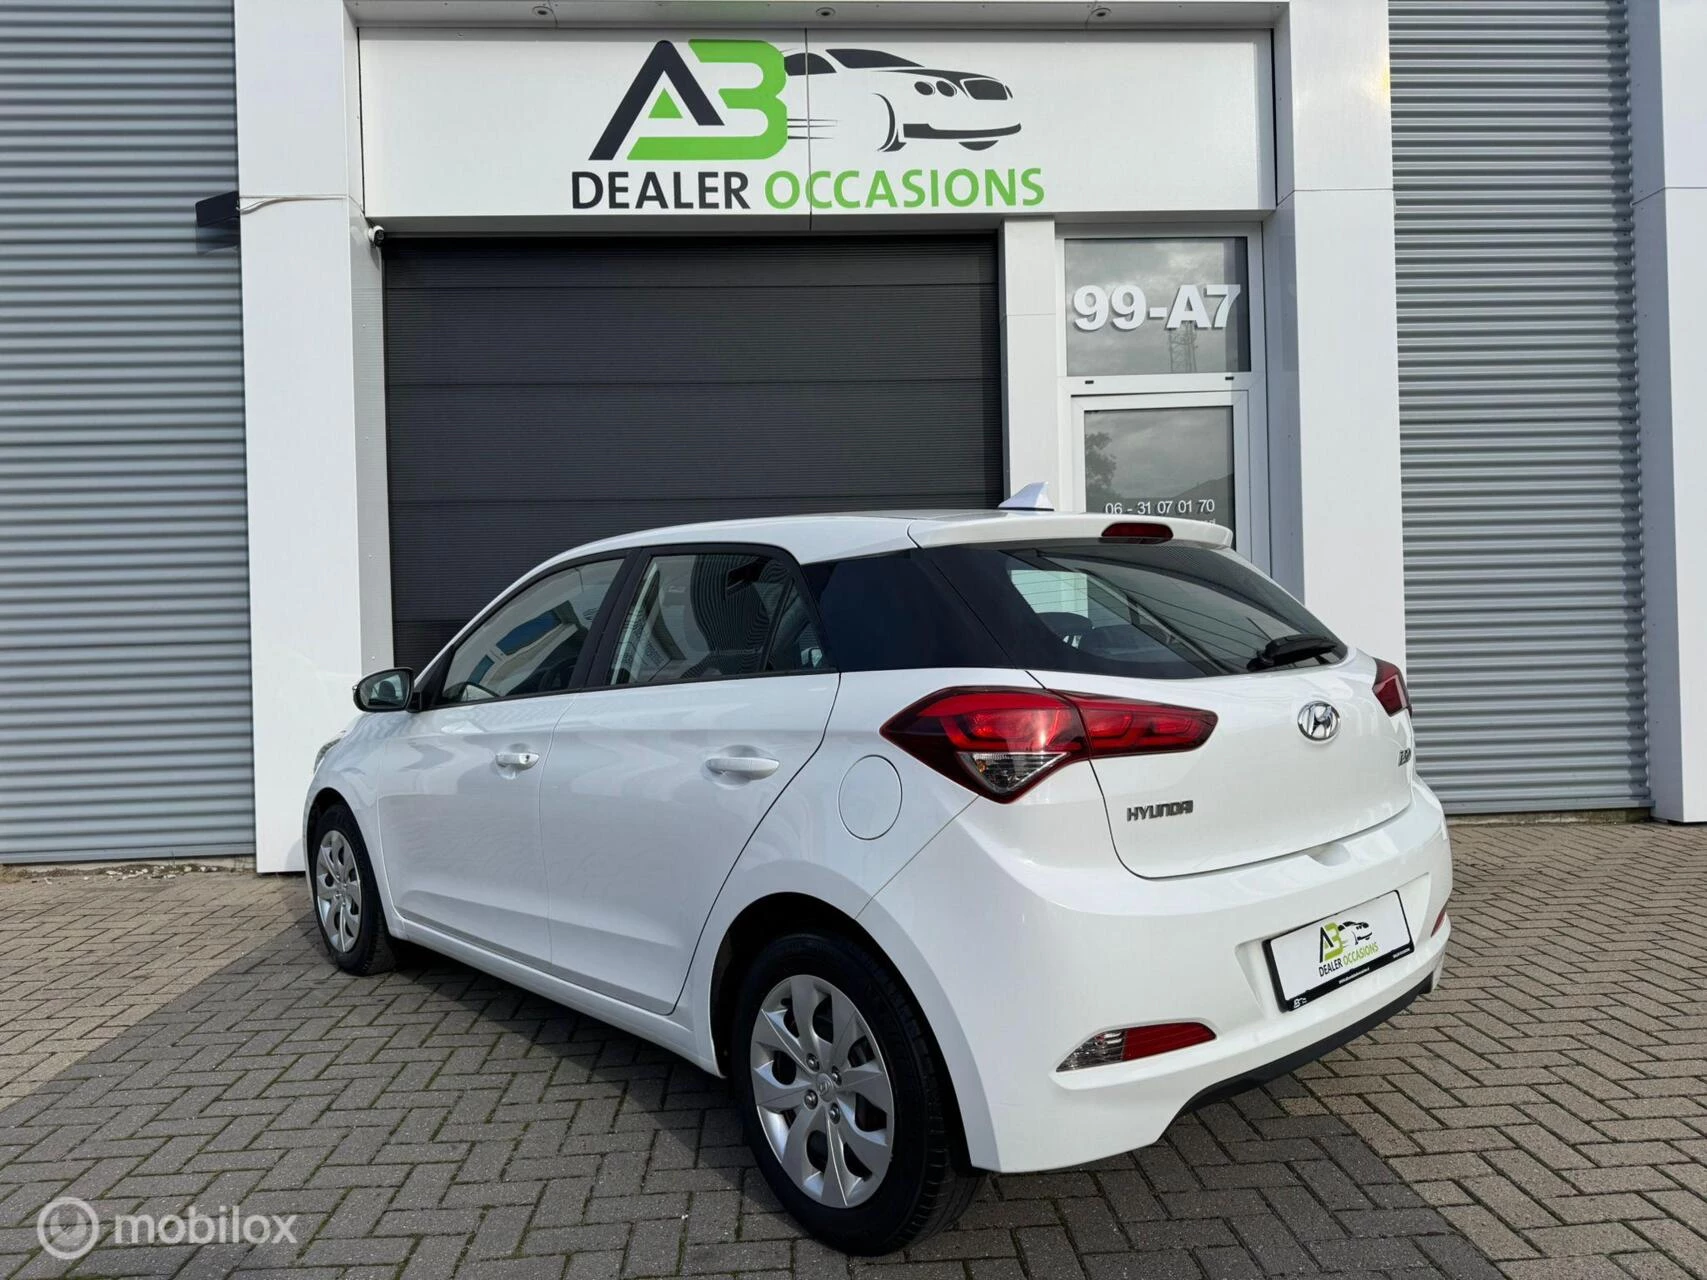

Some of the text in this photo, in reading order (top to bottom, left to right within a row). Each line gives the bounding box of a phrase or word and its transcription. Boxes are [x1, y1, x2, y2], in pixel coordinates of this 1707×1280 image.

[572, 167, 1045, 210] DEALER OCCASIONS
[1073, 284, 1241, 331] 99-A7
[1105, 502, 1123, 514] 06
[1137, 501, 1151, 514] 31
[1157, 500, 1172, 514] 07
[1178, 499, 1192, 513] 01
[1198, 499, 1215, 512] 70
[1126, 799, 1194, 822] HYUNDAI
[1318, 958, 1343, 977] DEALER
[1342, 942, 1379, 966] OCCASIONS
